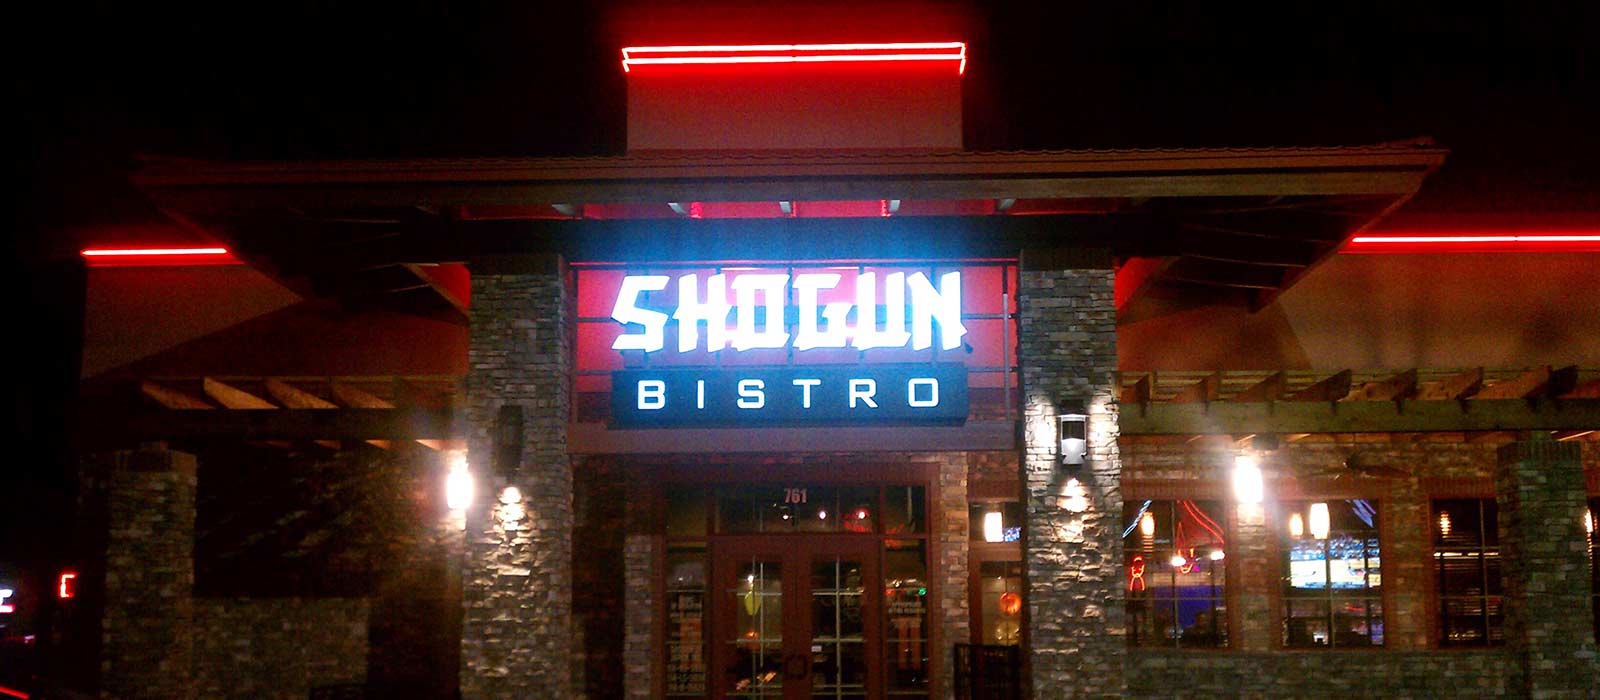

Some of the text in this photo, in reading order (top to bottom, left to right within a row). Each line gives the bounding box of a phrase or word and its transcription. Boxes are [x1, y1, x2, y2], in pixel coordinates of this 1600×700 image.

[611, 271, 968, 353] SHOGUN
[637, 377, 939, 410] BISTRO
[784, 488, 808, 504] 761
